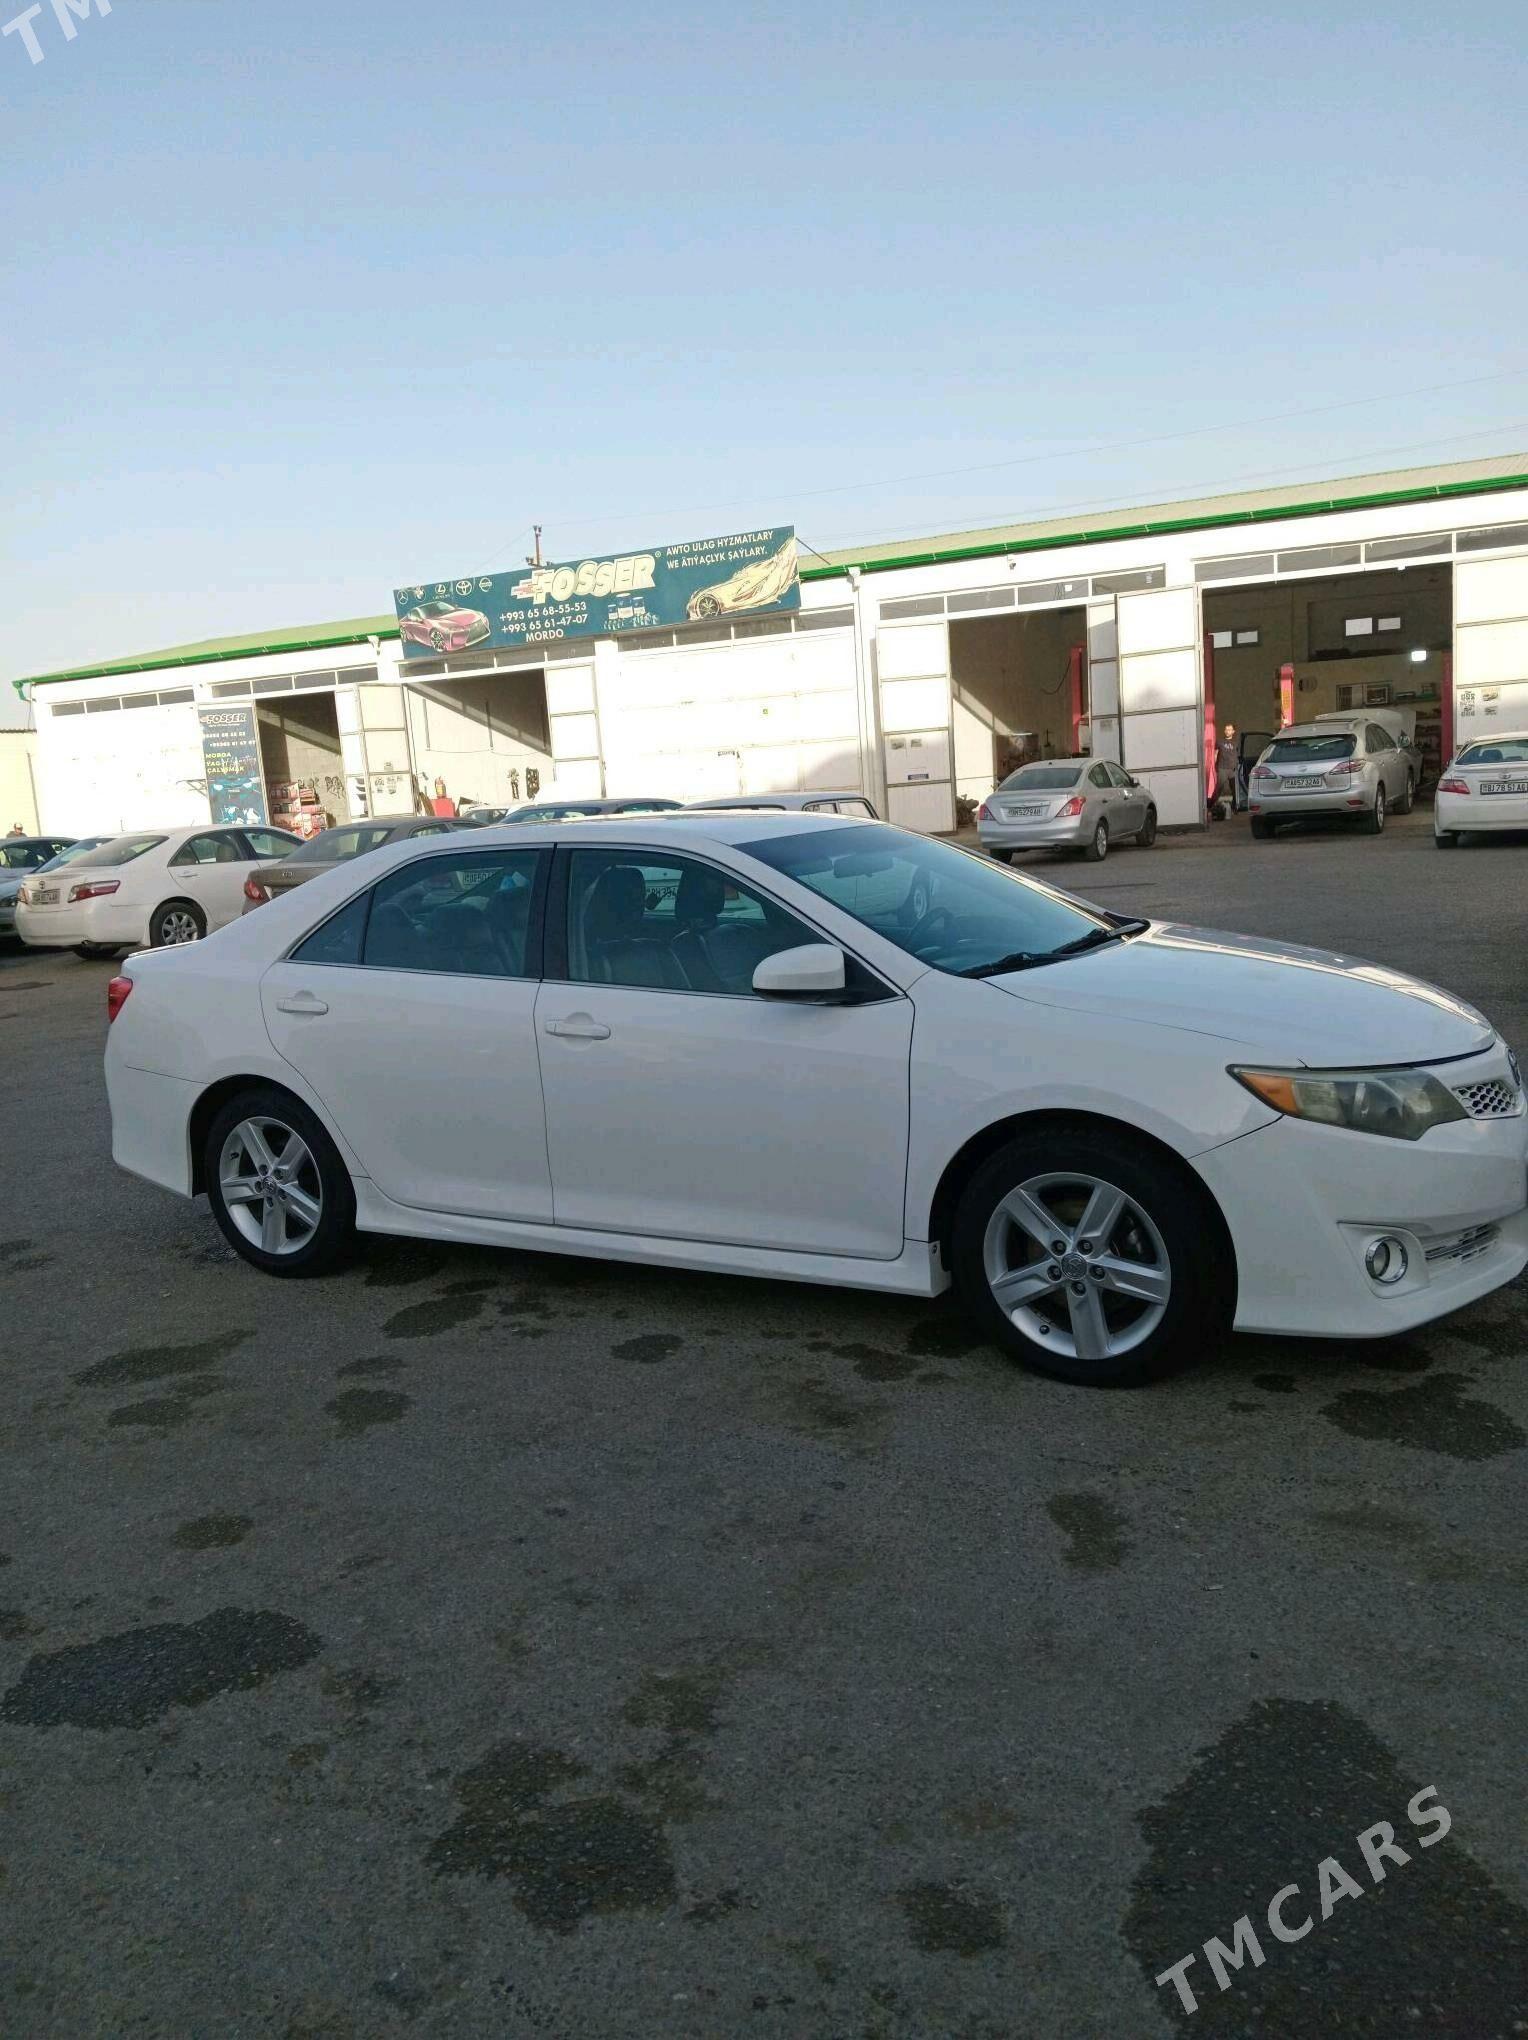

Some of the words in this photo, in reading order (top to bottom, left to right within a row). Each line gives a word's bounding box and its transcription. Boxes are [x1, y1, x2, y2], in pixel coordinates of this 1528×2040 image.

[666, 545, 690, 556] AWTO
[692, 541, 715, 552] ULAG
[717, 530, 774, 548] HYZMATLARY
[667, 558, 680, 569] WE
[530, 554, 656, 604] FOSSER
[499, 610, 525, 622] +993
[527, 608, 540, 618] 65
[542, 601, 587, 616] 68-55-53
[501, 622, 527, 634] +993
[529, 620, 542, 630] 65
[544, 614, 588, 628] 61-47-07
[525, 628, 564, 642] MORDO
[206, 712, 248, 724] FOSSER
